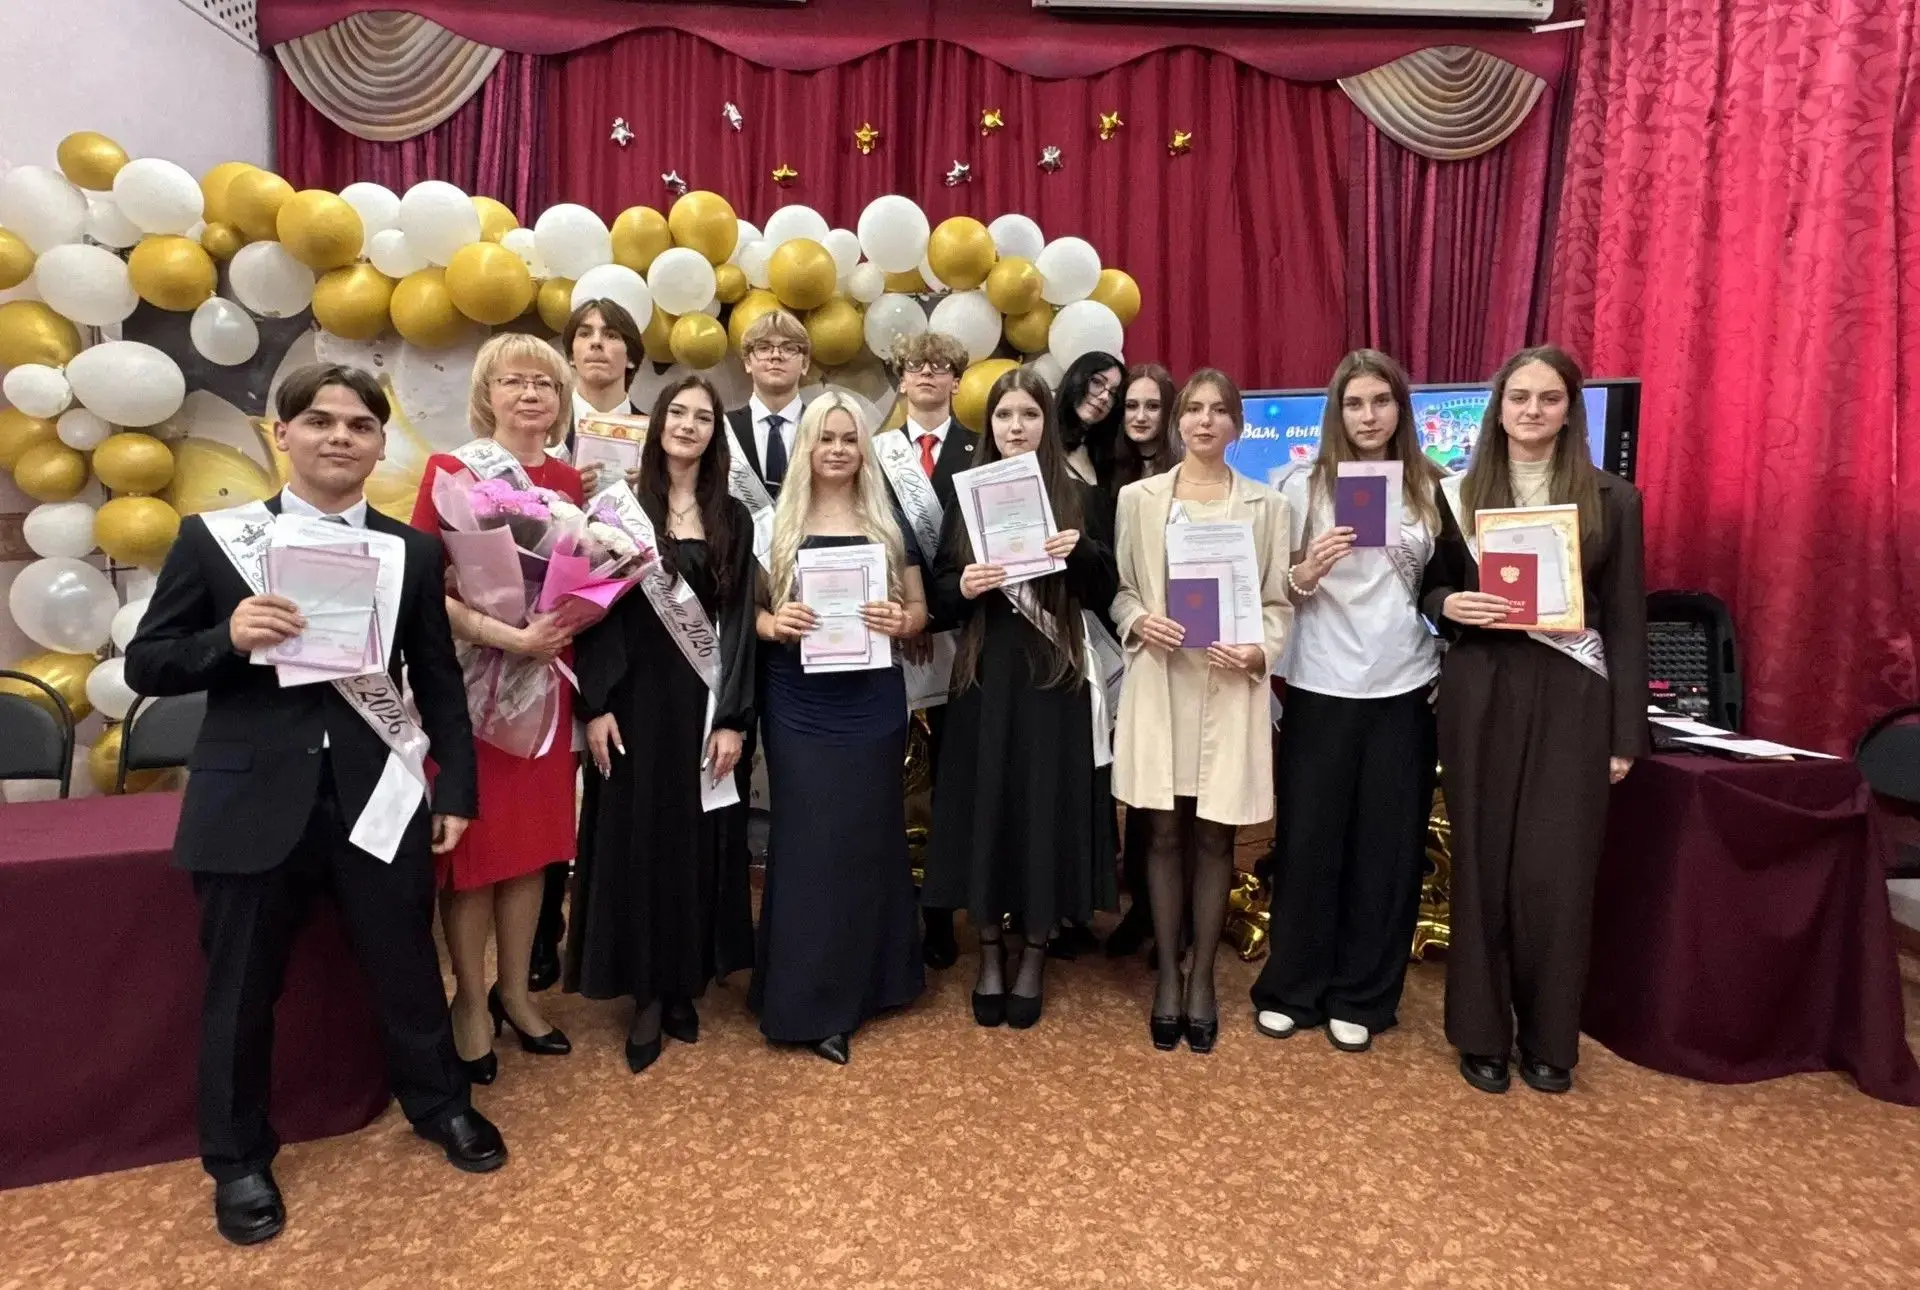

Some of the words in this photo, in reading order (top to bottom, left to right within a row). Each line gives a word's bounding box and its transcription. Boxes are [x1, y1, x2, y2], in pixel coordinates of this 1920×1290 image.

[1240, 422, 1280, 440] Вам,
[679, 620, 719, 657] 2026
[1563, 633, 1605, 661] 202
[355, 687, 408, 734] 2026
